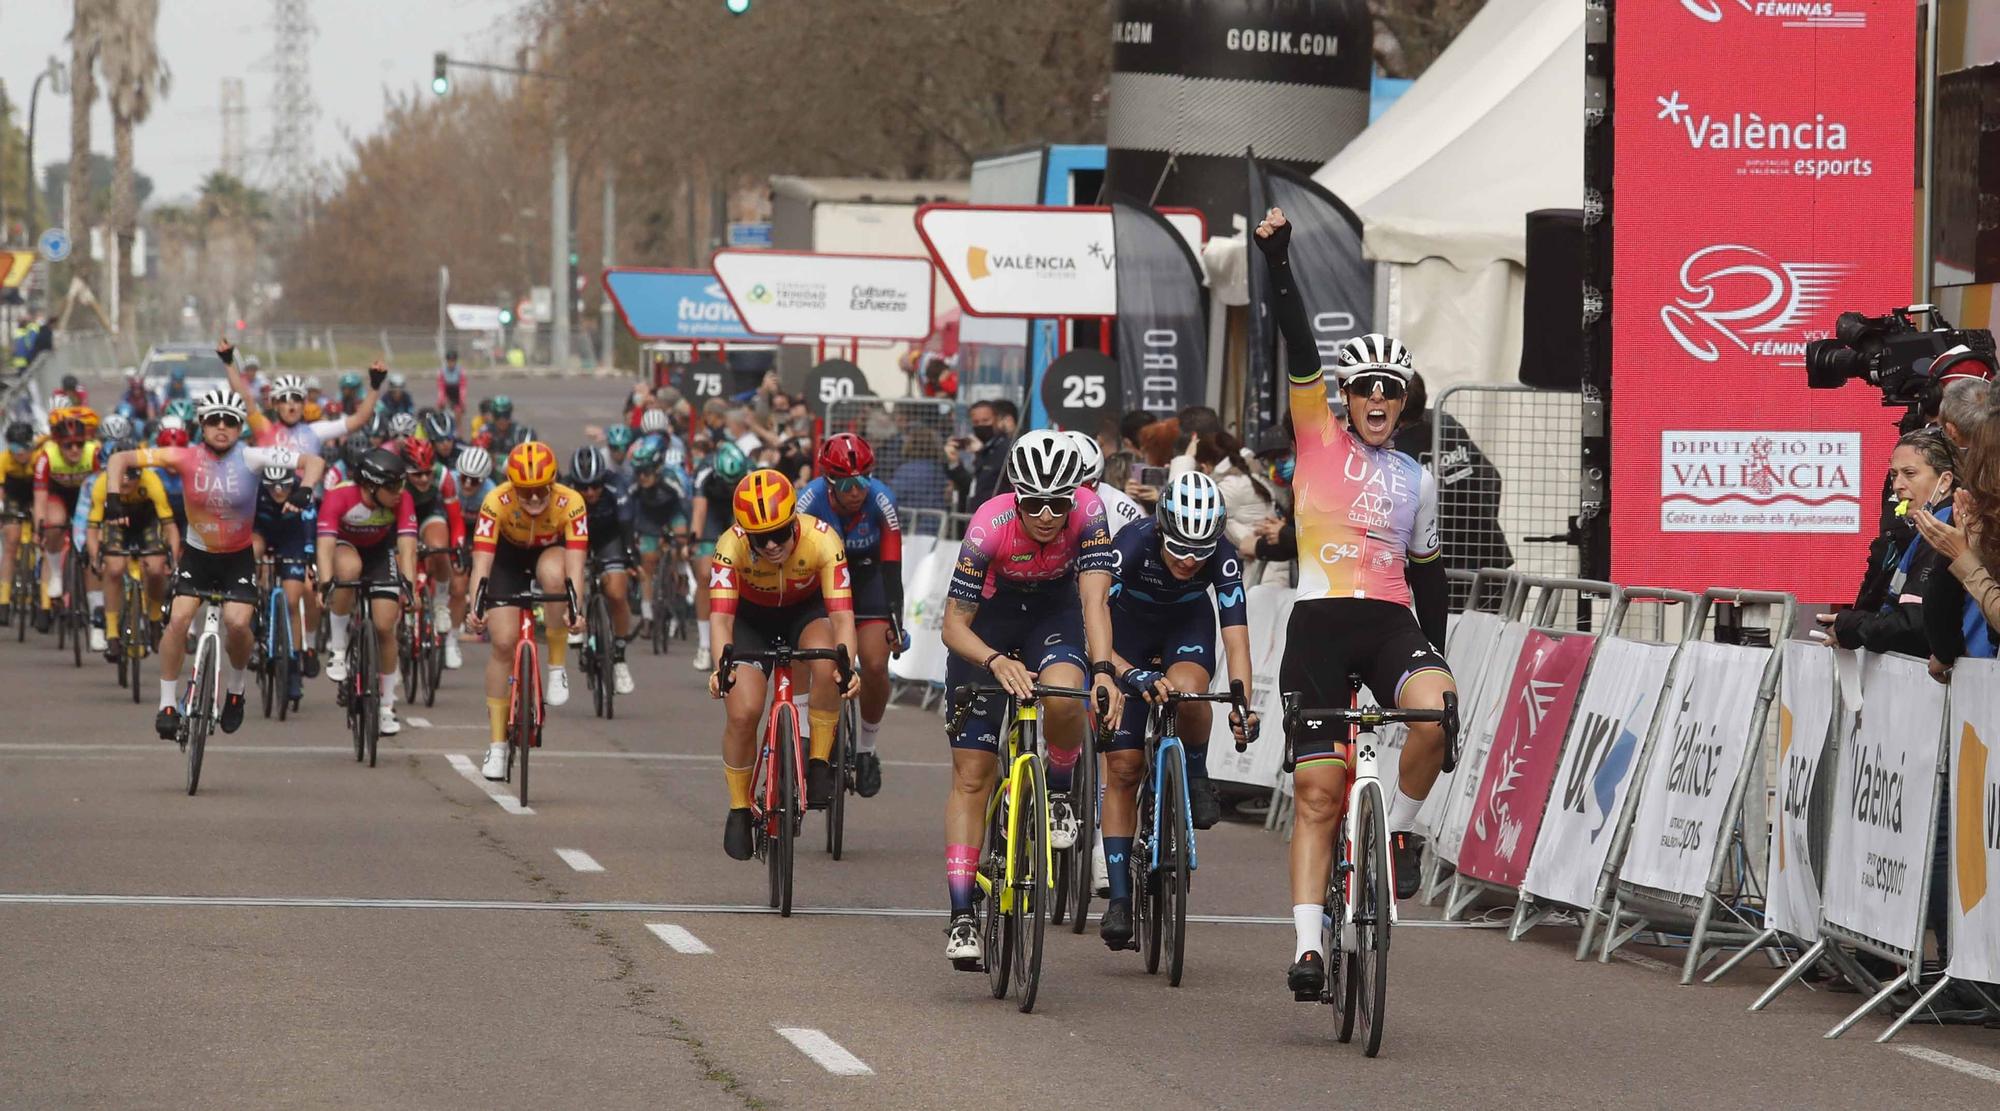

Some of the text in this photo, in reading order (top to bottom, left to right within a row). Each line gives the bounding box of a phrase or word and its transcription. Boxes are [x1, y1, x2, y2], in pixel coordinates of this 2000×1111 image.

[1226, 28, 1339, 57] GOBIK.COM
[1683, 112, 1848, 150] València
[1793, 157, 1873, 181] esports
[992, 253, 1076, 270] VALÈNCIA
[693, 373, 722, 396] 75
[819, 378, 855, 402] 50
[1062, 375, 1107, 408] 25
[1819, 441, 1849, 456] DE
[194, 472, 240, 494] UAE
